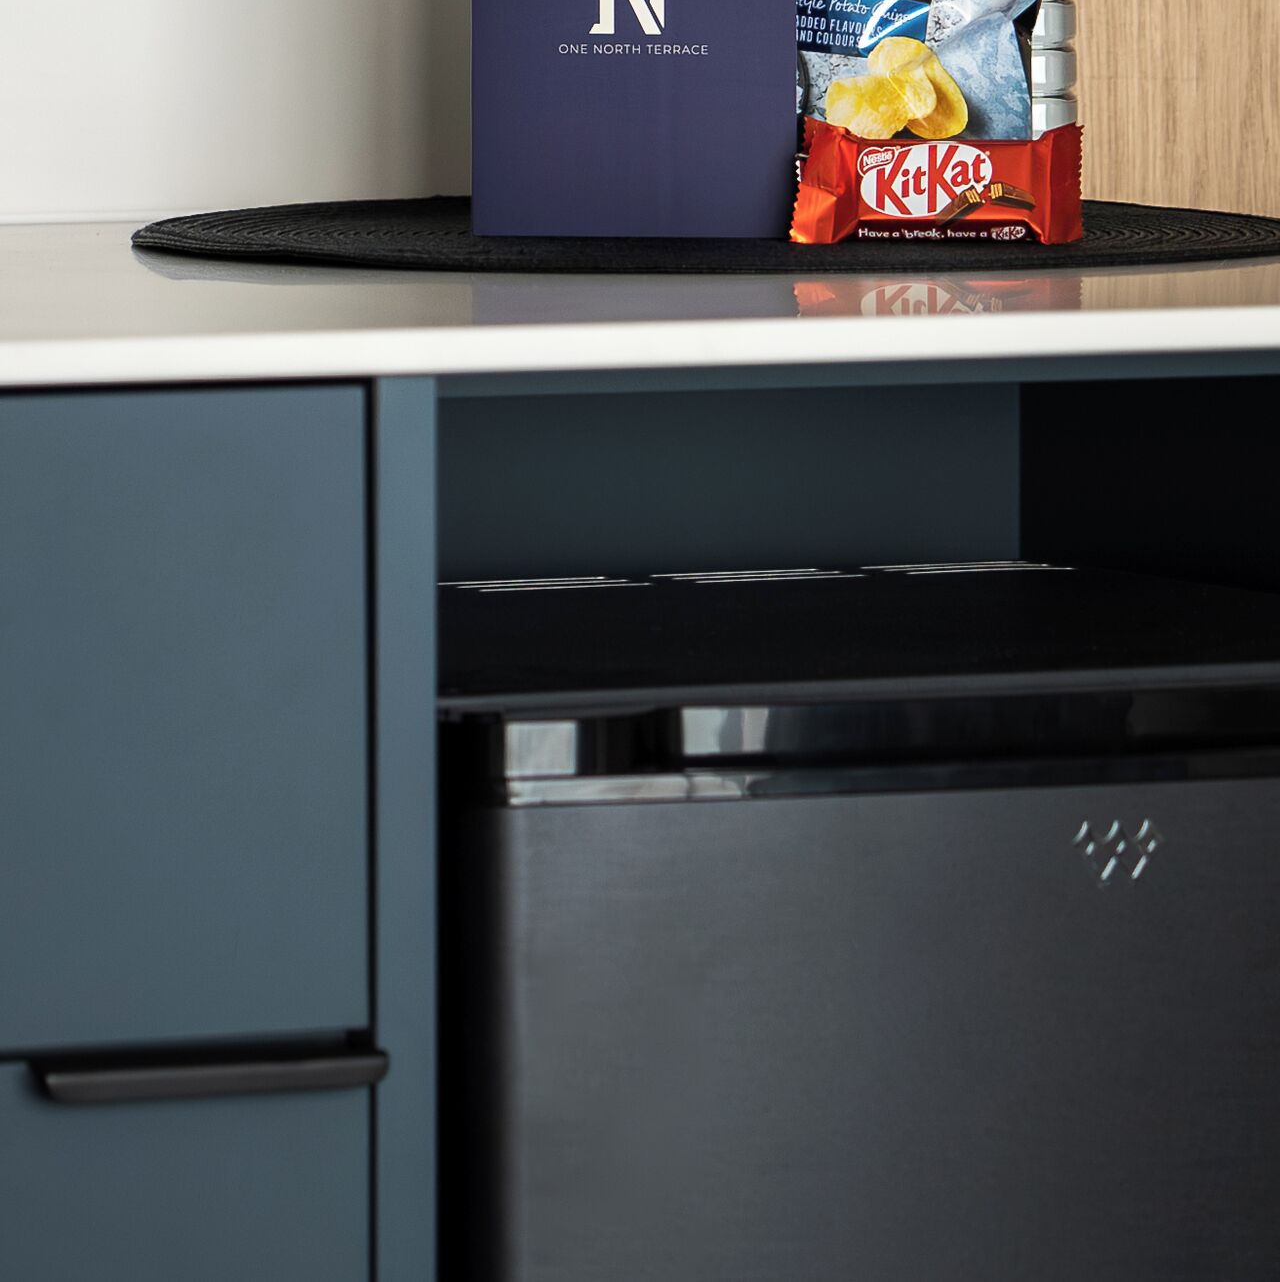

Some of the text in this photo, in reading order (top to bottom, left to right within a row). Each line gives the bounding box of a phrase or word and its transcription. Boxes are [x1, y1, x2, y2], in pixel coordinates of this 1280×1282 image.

[558, 43, 709, 55] ONE NORTH TERRACE
[858, 228, 890, 238] Have
[947, 229, 976, 238] have
